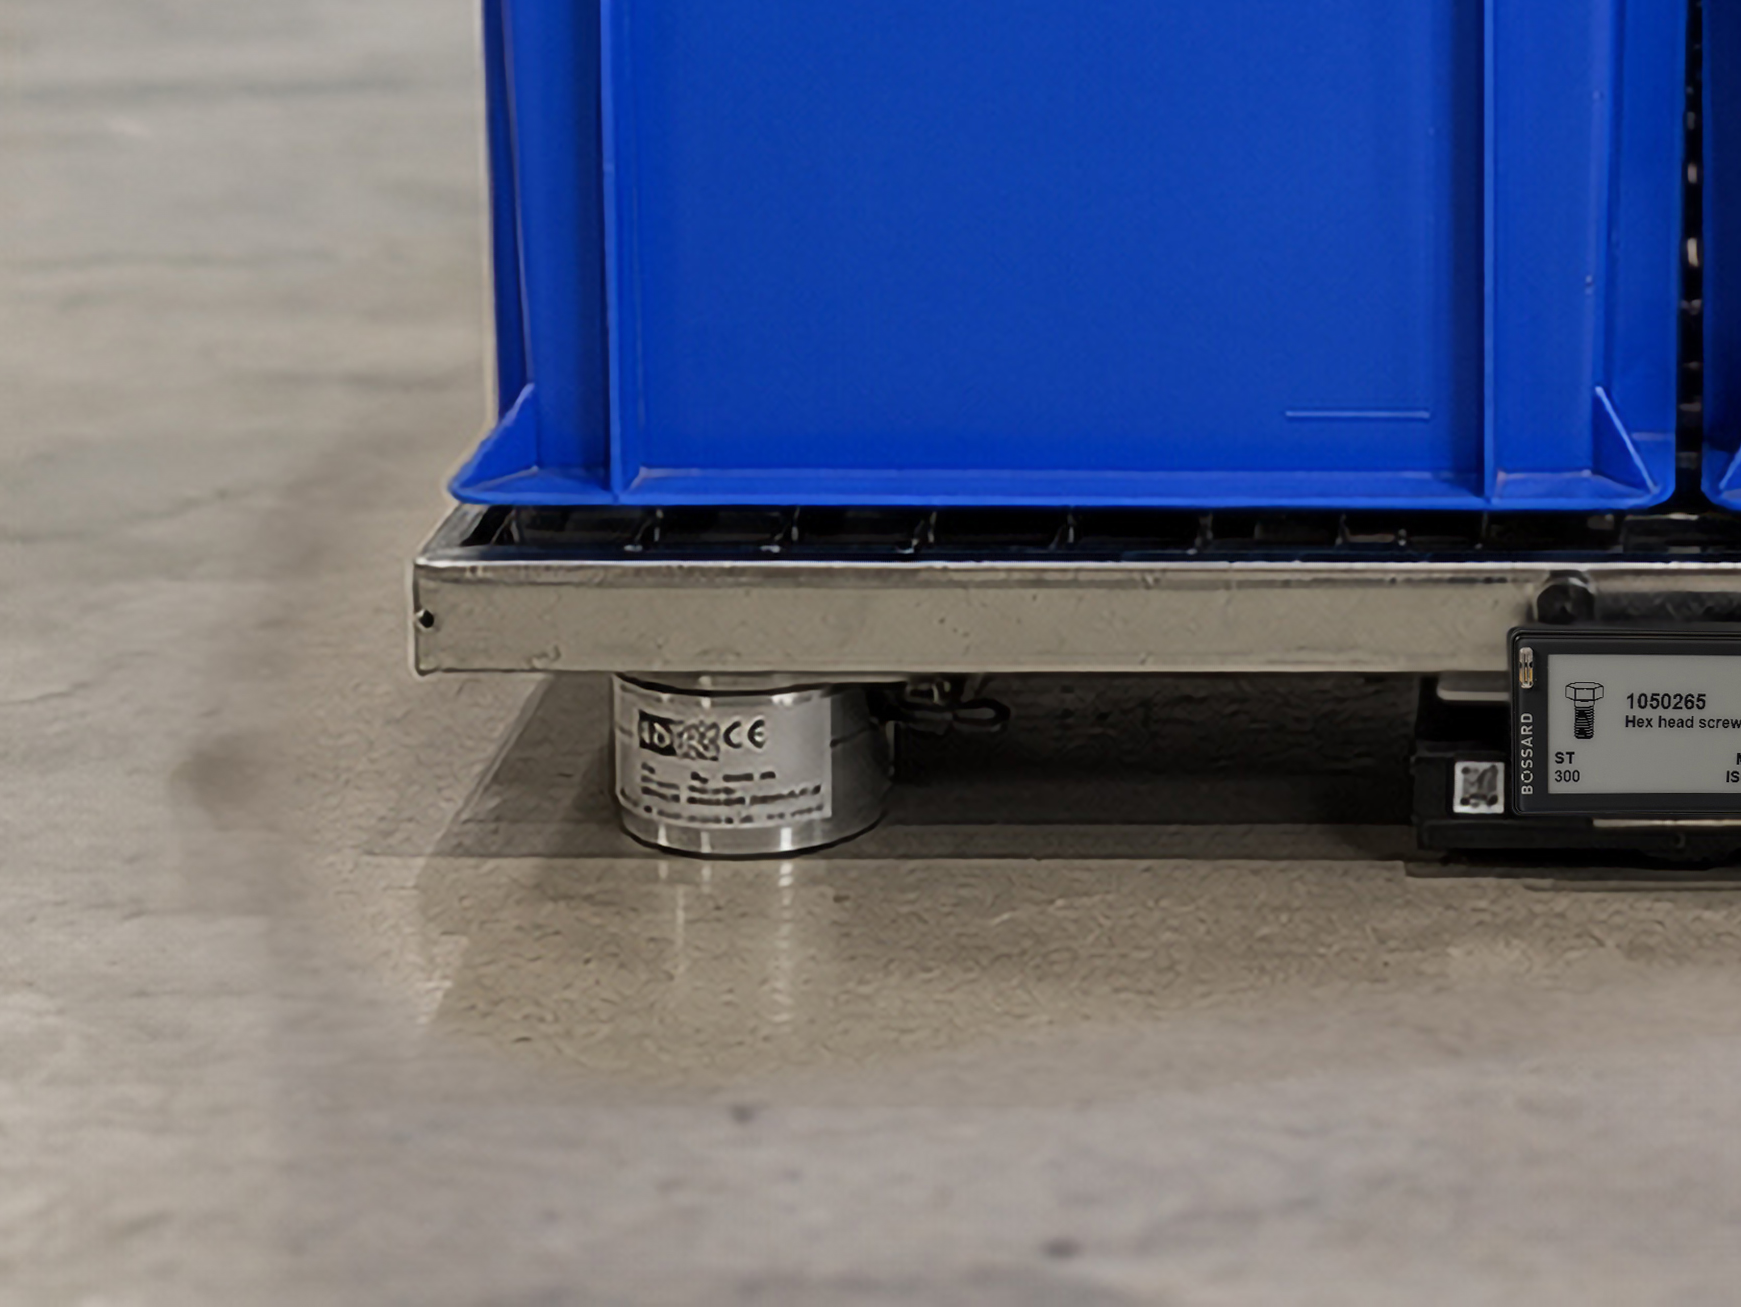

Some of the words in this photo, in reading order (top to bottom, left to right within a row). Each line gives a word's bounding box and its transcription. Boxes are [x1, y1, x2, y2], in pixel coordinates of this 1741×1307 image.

[1626, 692, 1707, 710] 1050265
[1624, 715, 1654, 728] Hex
[1658, 715, 1694, 729] head
[1520, 713, 1534, 795] BOSSARD
[1554, 751, 1576, 765] ST
[1554, 769, 1581, 783] 300
